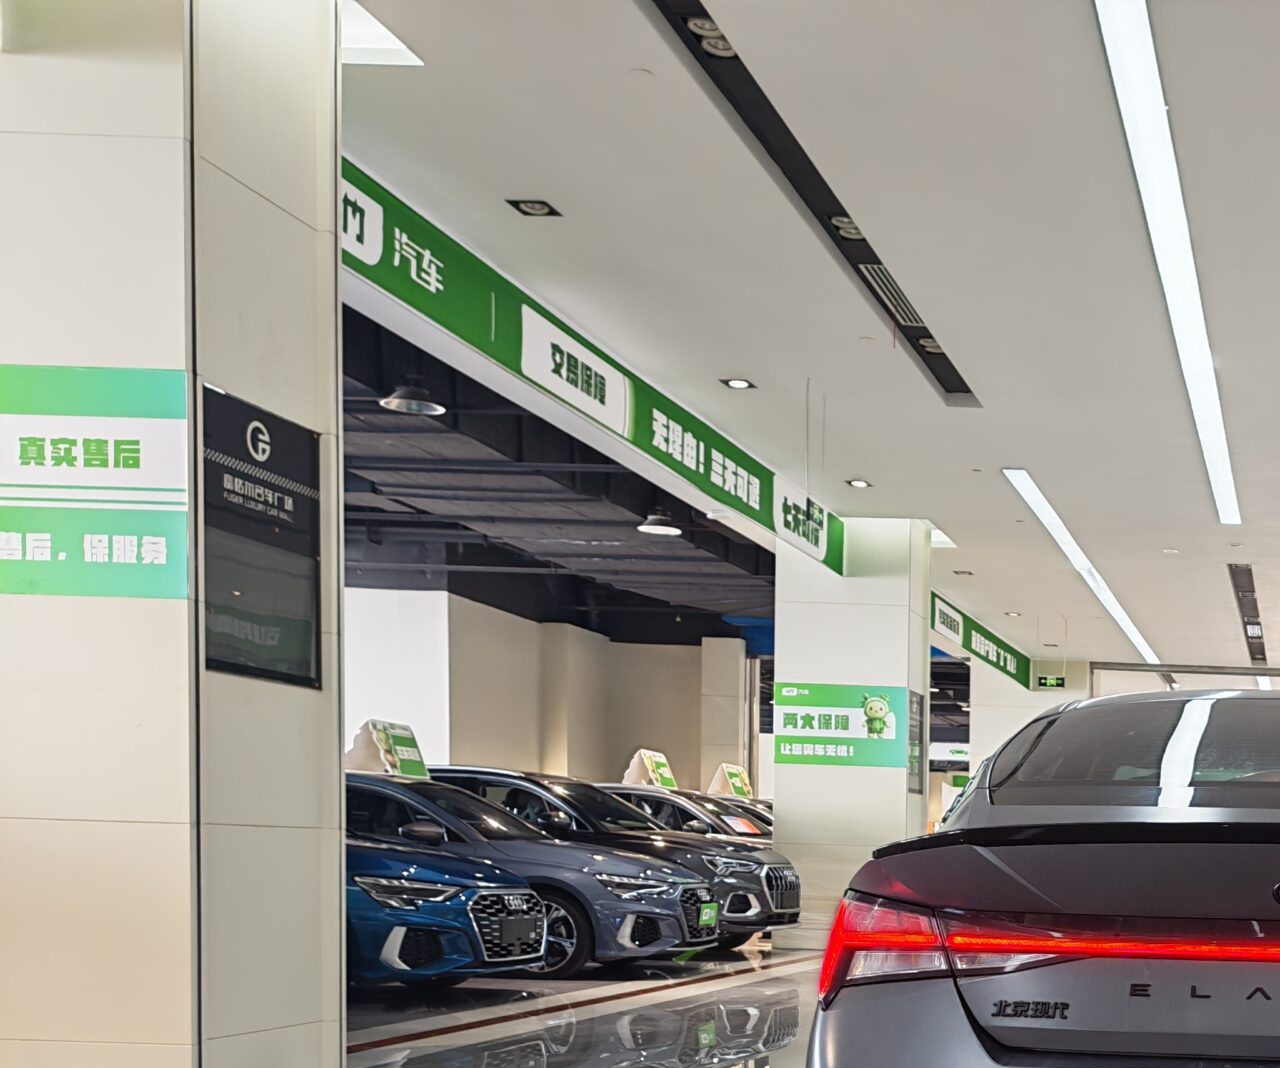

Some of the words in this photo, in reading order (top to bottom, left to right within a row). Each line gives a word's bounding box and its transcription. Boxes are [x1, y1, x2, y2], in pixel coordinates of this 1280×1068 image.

[393, 226, 445, 294] 汽车
[19, 437, 141, 469] 真实售后
[783, 712, 849, 731] 两大保障
[991, 1000, 1070, 1019] 北京现代
